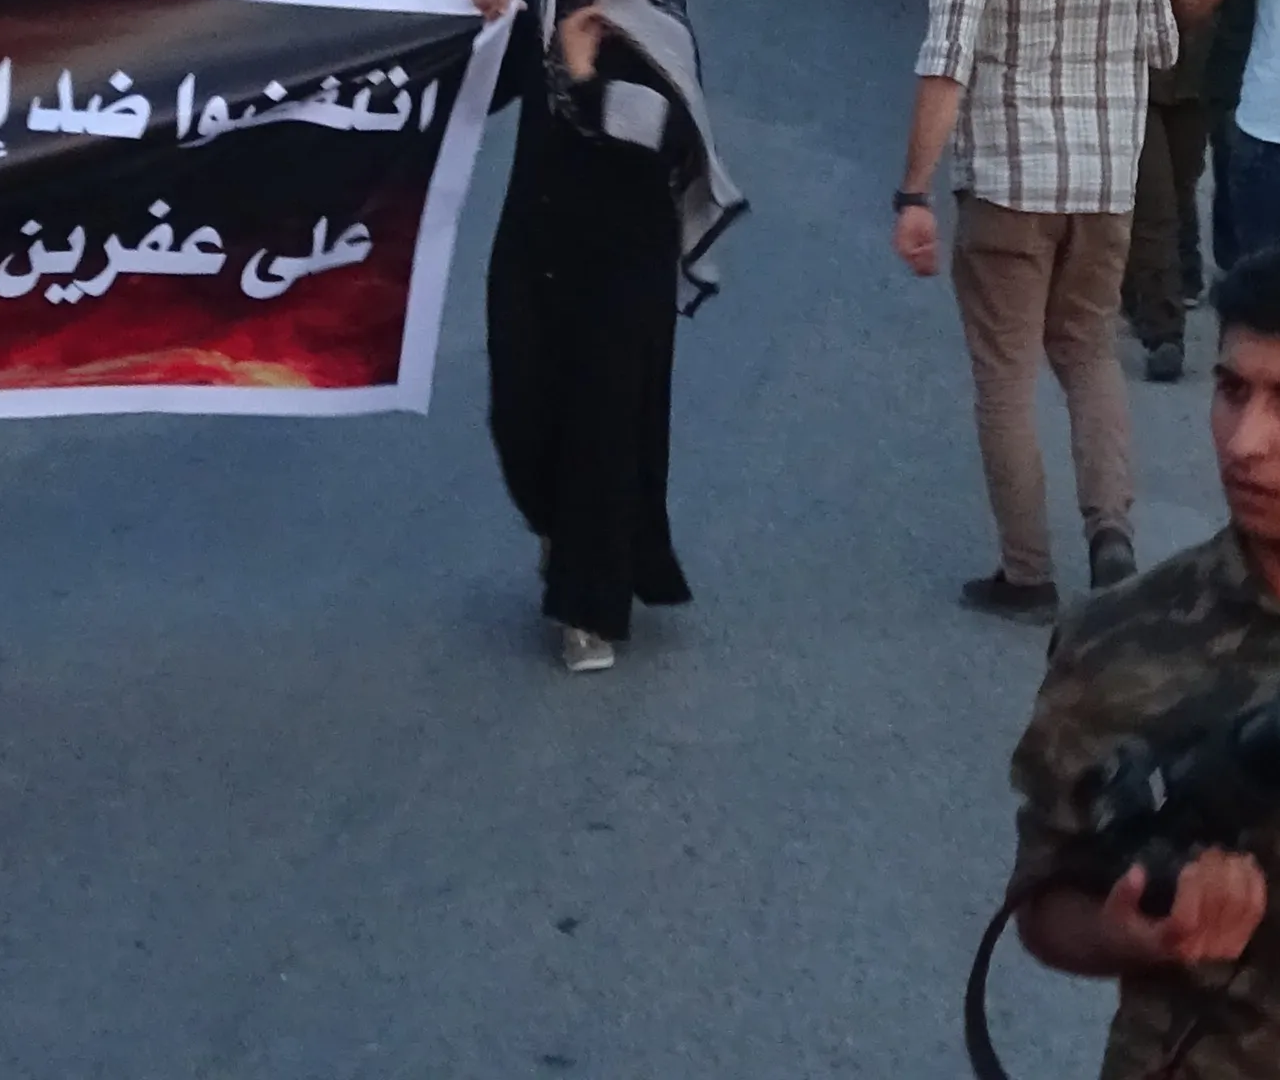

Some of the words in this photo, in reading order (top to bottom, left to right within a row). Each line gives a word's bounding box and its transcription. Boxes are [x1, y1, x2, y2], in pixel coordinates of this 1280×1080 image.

[27, 69, 151, 140] ضد
[177, 65, 439, 148] انتفضوا
[240, 216, 374, 299] على
